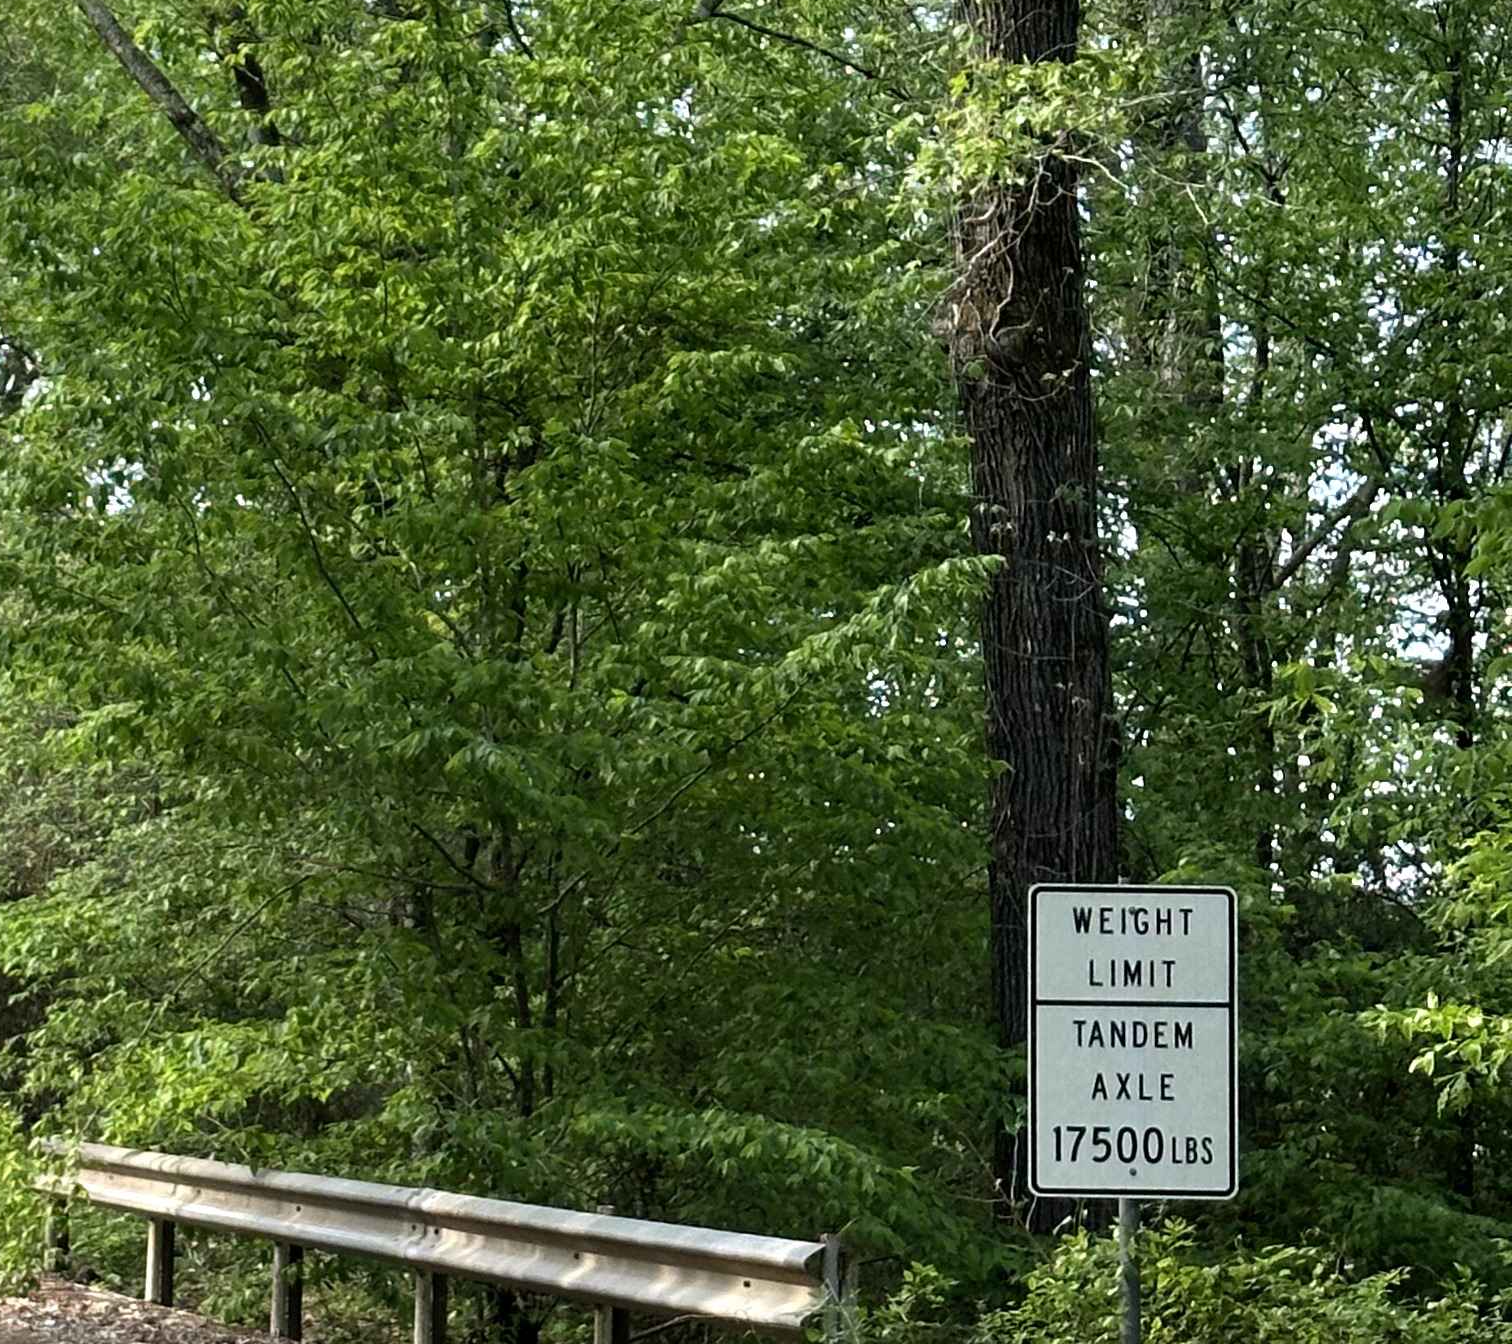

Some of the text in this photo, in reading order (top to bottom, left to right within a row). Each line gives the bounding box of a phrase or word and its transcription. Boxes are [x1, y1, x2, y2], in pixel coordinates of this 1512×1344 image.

[1073, 907, 1193, 935] WEIGHT
[1089, 960, 1176, 987] LIMIT
[1073, 1020, 1193, 1049] TANDEM
[1092, 1073, 1175, 1101] AXLE
